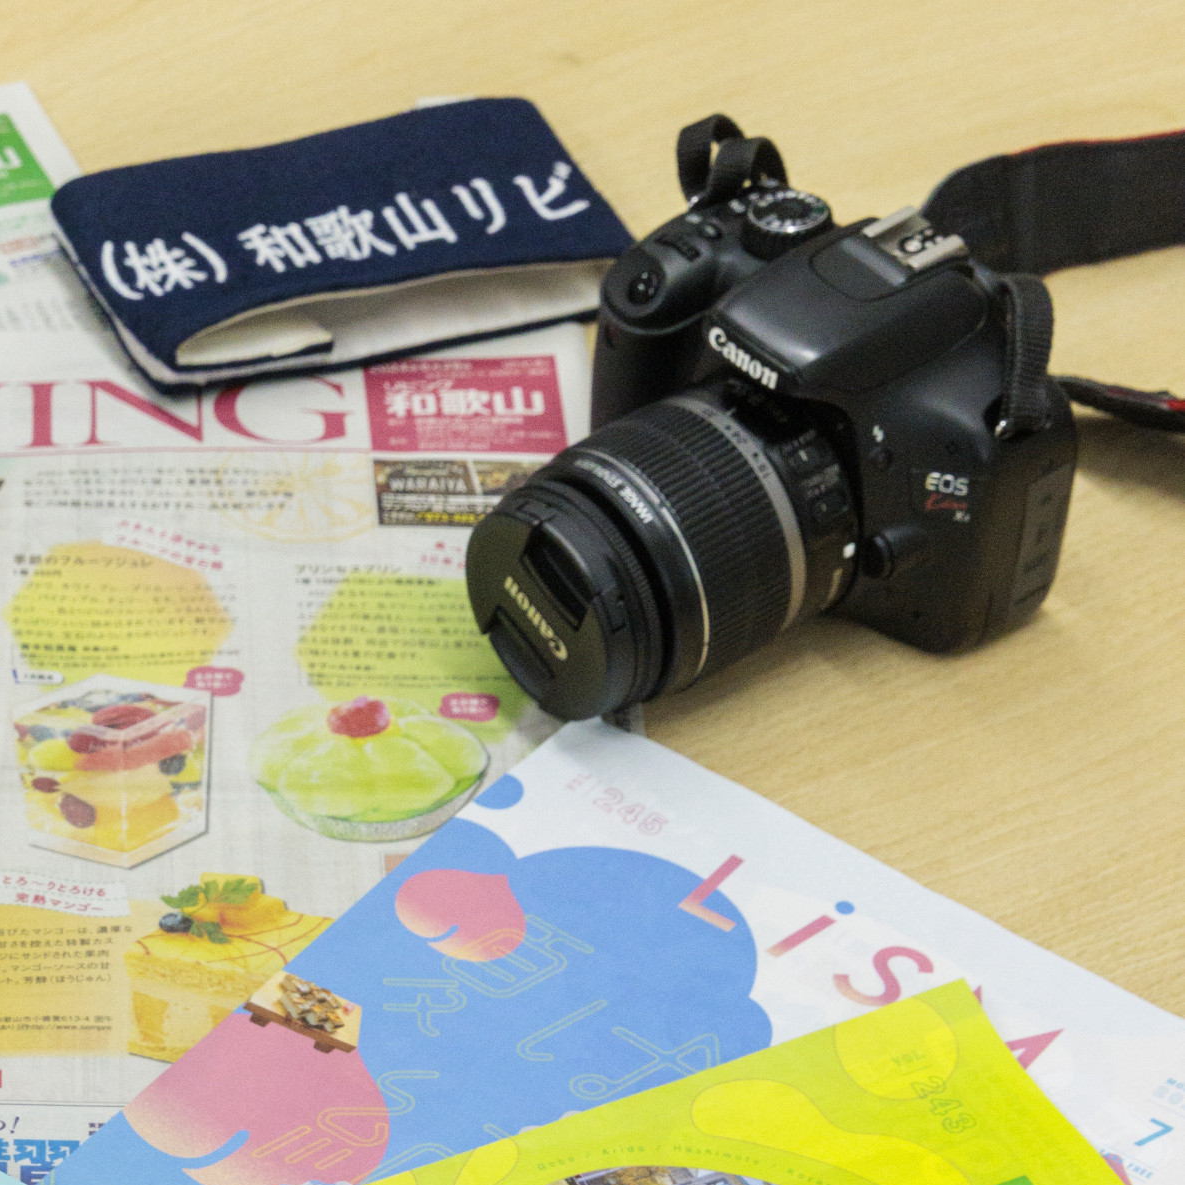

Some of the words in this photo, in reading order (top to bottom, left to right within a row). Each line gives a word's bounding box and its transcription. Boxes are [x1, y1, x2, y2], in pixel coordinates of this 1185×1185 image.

[707, 326, 780, 391] Canon
[385, 386, 545, 418] 和歌山
[925, 471, 970, 496] EOS
[503, 574, 570, 662] Canon
[1133, 1117, 1174, 1147] 7
